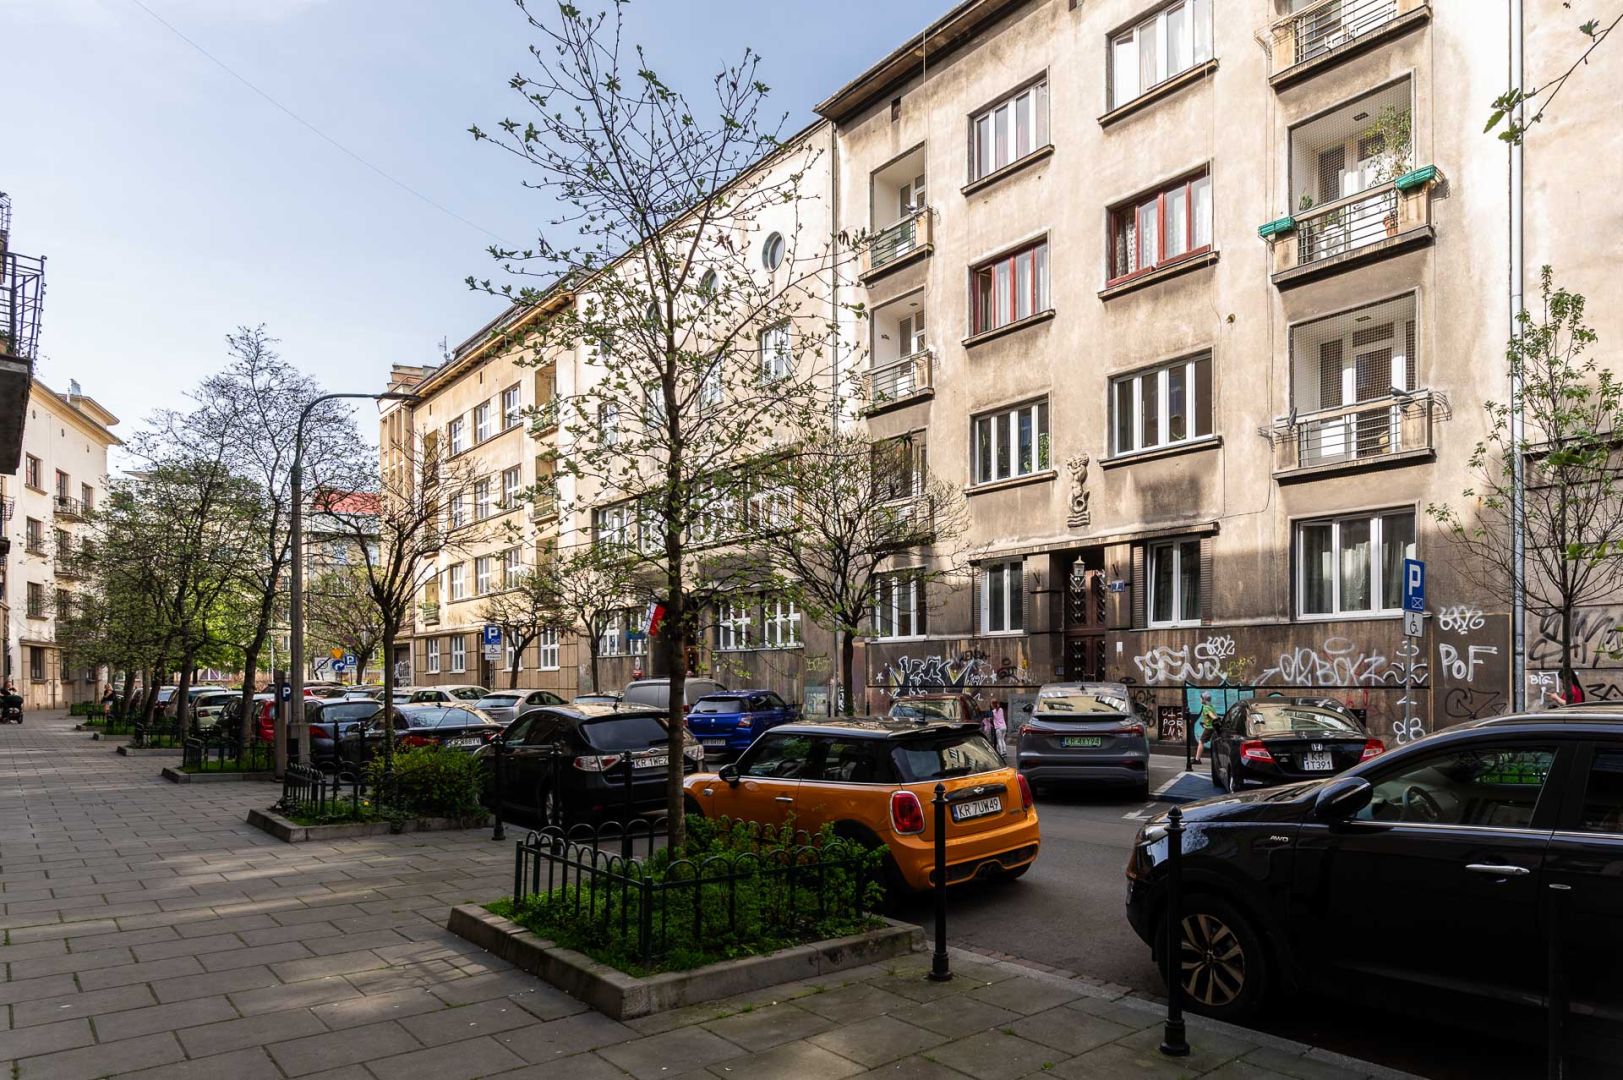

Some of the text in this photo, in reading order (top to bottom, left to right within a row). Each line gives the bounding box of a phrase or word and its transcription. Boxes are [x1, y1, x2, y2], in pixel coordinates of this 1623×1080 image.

[1408, 564, 1421, 595] P
[488, 627, 498, 639] P
[346, 655, 355, 665] P
[282, 686, 291, 698] P
[1311, 752, 1325, 761] KR
[635, 759, 647, 768] KR
[1305, 760, 1332, 770] 1T391
[959, 805, 971, 817] KR
[972, 799, 999, 815] 7UW49
